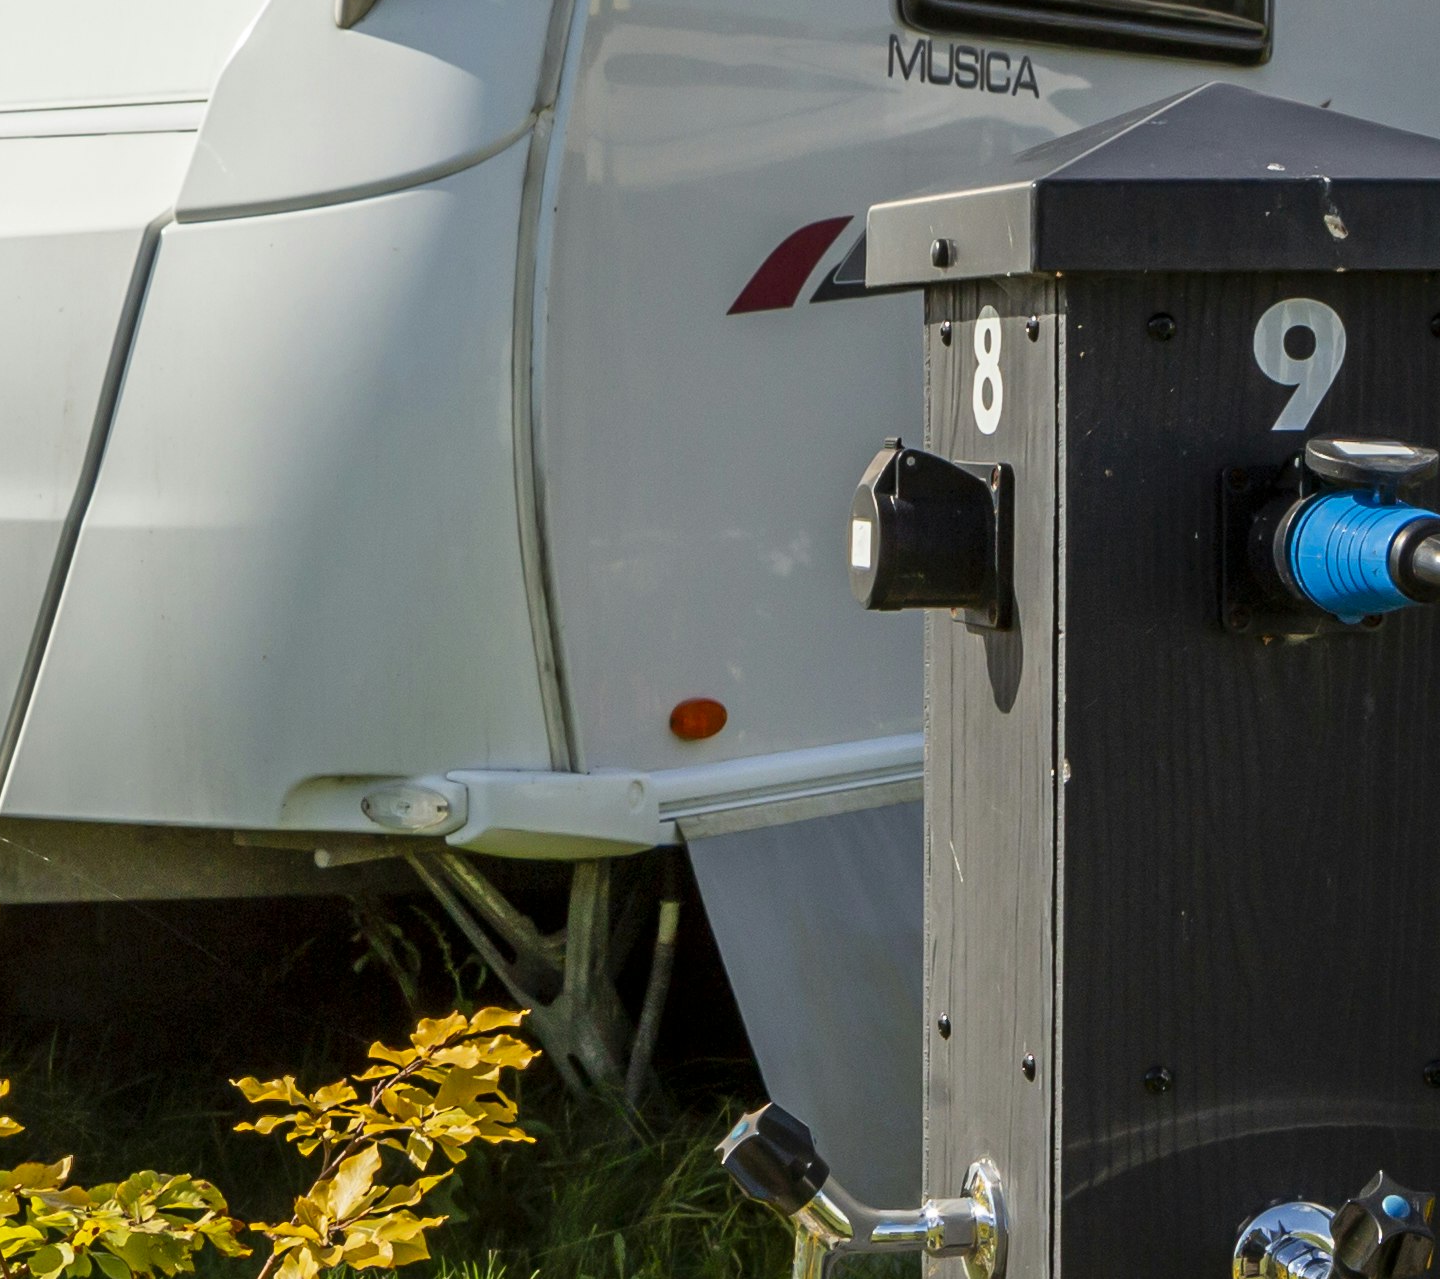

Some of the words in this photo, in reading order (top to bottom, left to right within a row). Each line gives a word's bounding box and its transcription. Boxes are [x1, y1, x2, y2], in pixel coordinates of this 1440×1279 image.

[887, 33, 1040, 99] MUSICA
[972, 305, 1004, 435] 8
[1253, 297, 1347, 432] 9
